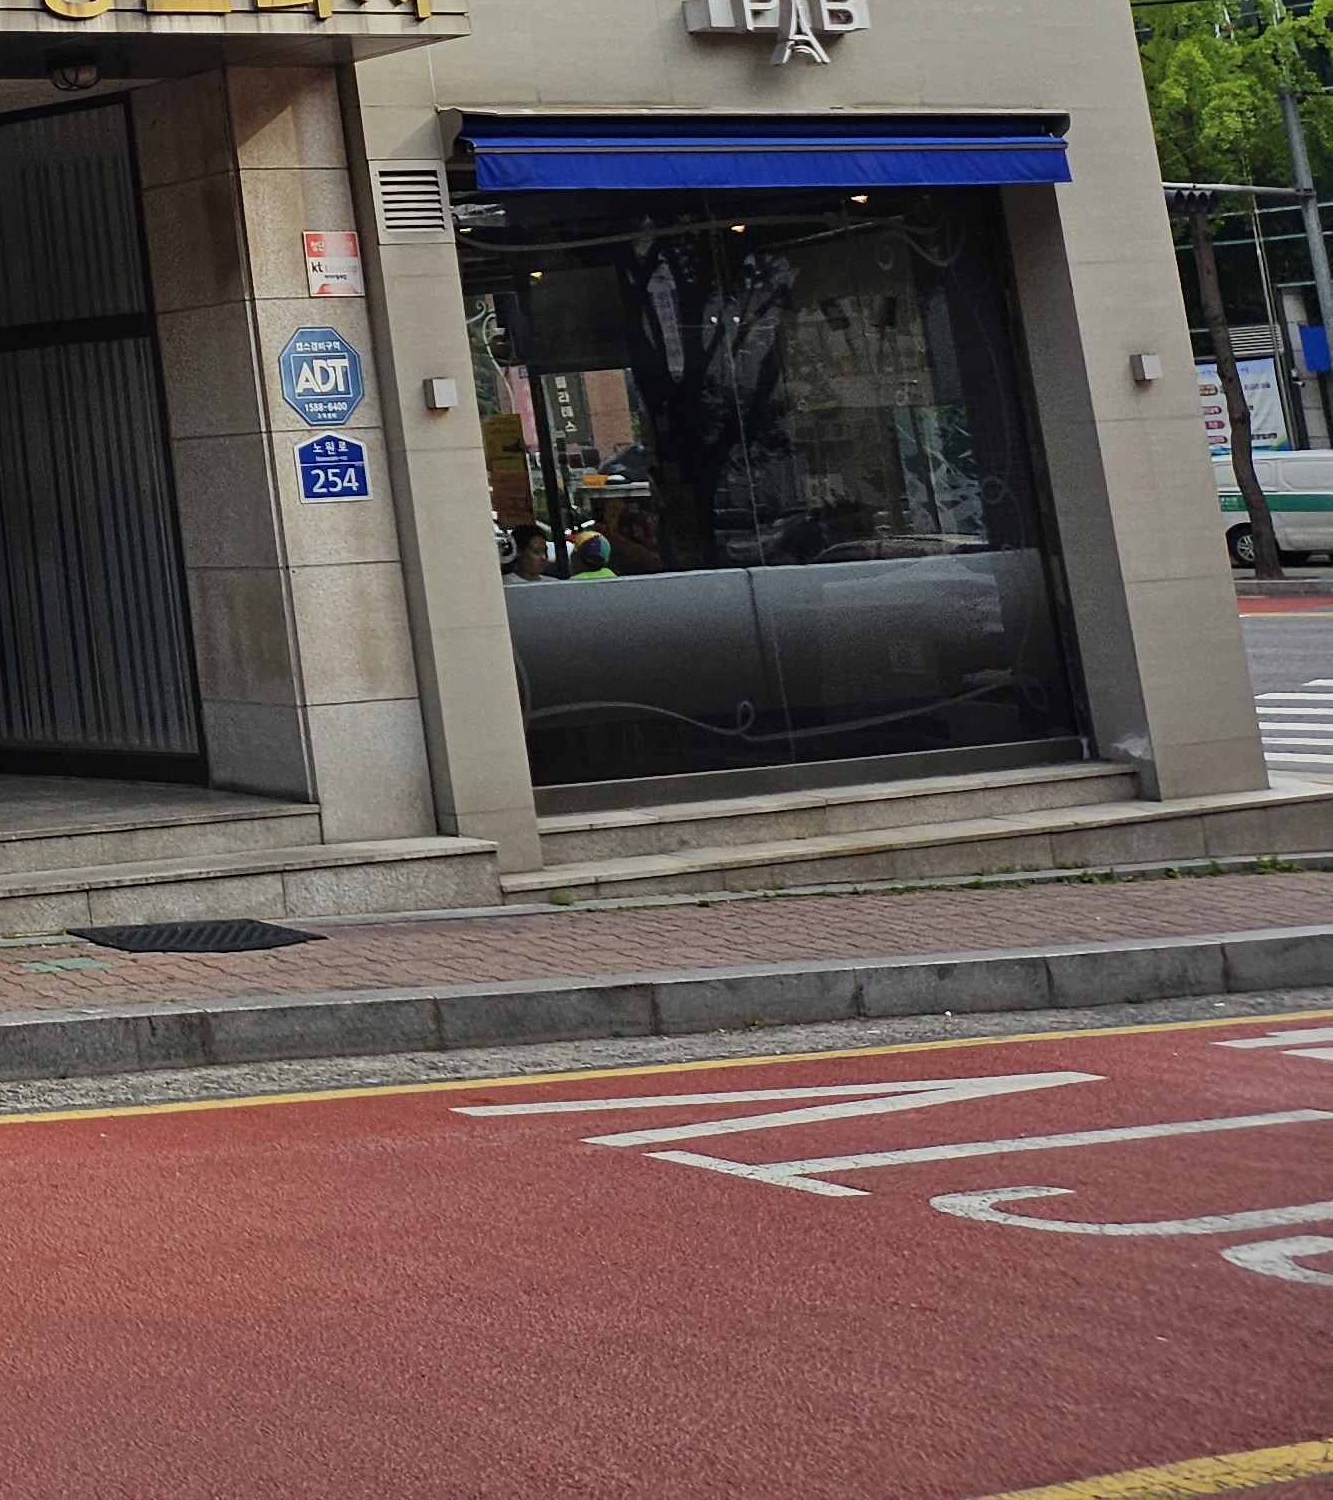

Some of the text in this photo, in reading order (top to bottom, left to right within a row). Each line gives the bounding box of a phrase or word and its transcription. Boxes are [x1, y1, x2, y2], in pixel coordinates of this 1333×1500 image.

[311, 261, 324, 274] kt
[295, 358, 349, 393] ADT
[304, 401, 348, 413] 1588-6400
[312, 441, 349, 456] 노원로
[310, 467, 360, 493] 254
